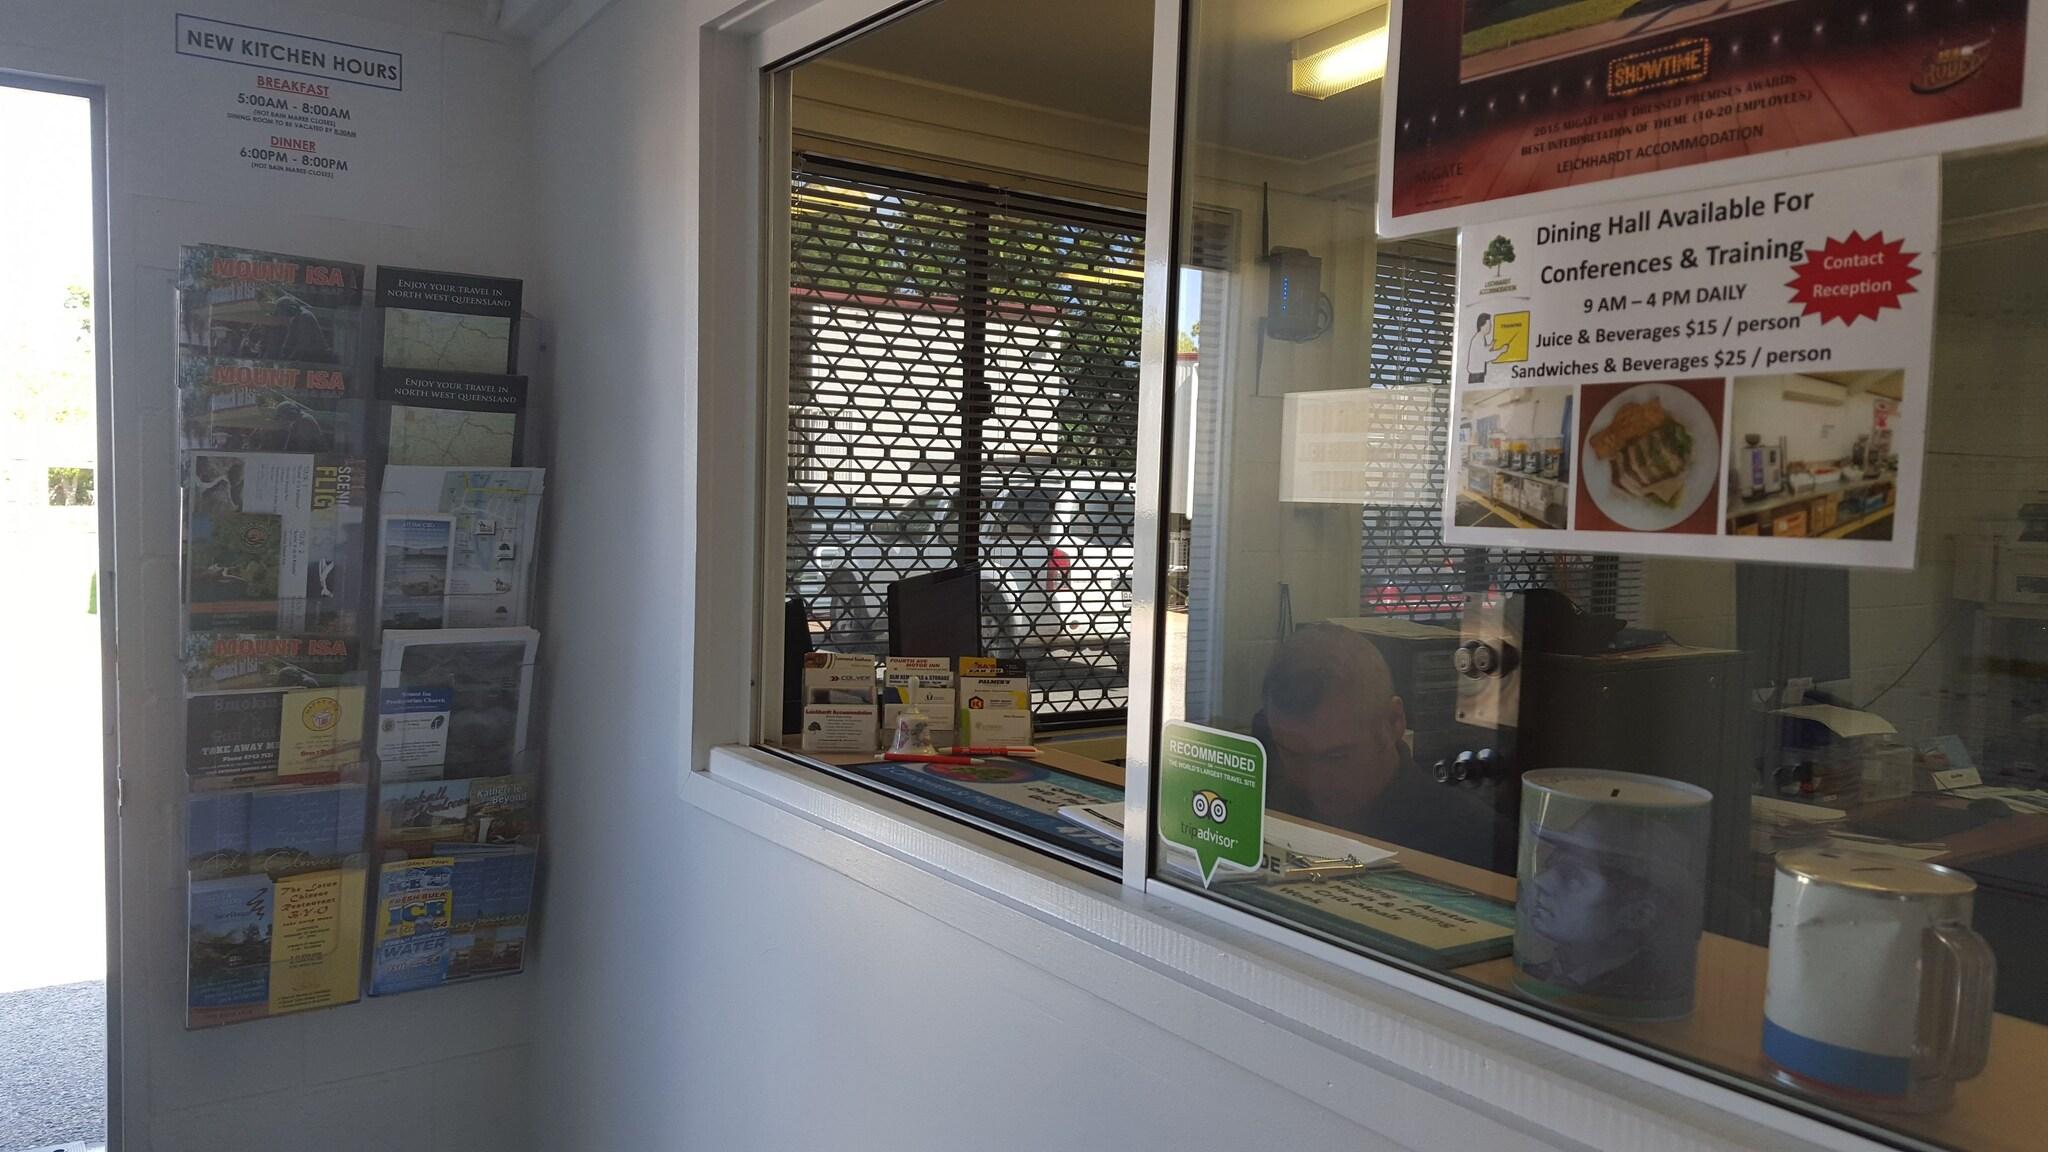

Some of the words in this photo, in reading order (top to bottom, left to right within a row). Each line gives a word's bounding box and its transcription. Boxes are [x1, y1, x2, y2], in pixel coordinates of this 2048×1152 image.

[187, 29, 235, 52] NEW
[241, 39, 326, 69] KITCHEN
[333, 55, 398, 81] HOURS
[1613, 50, 1701, 87] SHOWTIME
[256, 75, 329, 98] BREAKFAST
[1602, 109, 1628, 122] BEST
[1631, 97, 1680, 117] DRESSED
[1685, 87, 1742, 105] PREMISES
[1746, 73, 1798, 92] AWARDS
[237, 92, 289, 110] 5:00AM
[301, 102, 351, 120] 8:00AM
[1520, 142, 1545, 156] BEST
[1548, 125, 1633, 150] INTERPRETATION
[1636, 122, 1648, 132] OF
[1653, 113, 1687, 129] THEME
[1692, 104, 1733, 123] (10-20
[1736, 90, 1813, 113] EMPLOYEES)
[270, 135, 316, 153] DINNER
[1556, 148, 1633, 173] LEICHHARDT
[1636, 123, 1764, 159] ACCOMMODATION
[239, 146, 289, 163] 6:00PM
[301, 154, 349, 171] 8:00PM
[1536, 221, 1602, 246] Dining
[1608, 209, 1651, 236] Hall
[1657, 195, 1766, 230] Available
[1773, 192, 1815, 214] For
[211, 257, 299, 284] MOUNT
[305, 264, 345, 287] ISA
[1540, 254, 1673, 284] Conferences
[1679, 248, 1699, 269] &
[1706, 238, 1805, 267] Training
[1823, 252, 1885, 271] Contact
[387, 289, 421, 300] NORTH
[424, 292, 451, 302] WEST
[451, 294, 511, 307] QUEENSLAND
[399, 279, 430, 290] ENJOY
[430, 281, 456, 292] YOUR
[458, 285, 490, 296] TRAVEL
[1583, 299, 1594, 314] 9
[1598, 296, 1627, 313] AM
[1646, 293, 1657, 308] 4
[1662, 290, 1691, 307] PM
[1696, 282, 1748, 304] DAILY
[1812, 278, 1893, 298] Reception
[1535, 331, 1573, 348] Juice
[1577, 329, 1591, 344] &
[1595, 323, 1681, 343] Beverages
[1685, 318, 1718, 338] $15
[1722, 316, 1733, 337] /
[1737, 315, 1801, 336] person
[1511, 362, 1600, 379] Sandwiches
[1603, 358, 1617, 373] &
[1622, 353, 1709, 372] Beverages
[1714, 349, 1747, 369] $25
[1751, 347, 1762, 368] /
[1766, 347, 1832, 367] person
[212, 364, 300, 389] MOUNT
[306, 369, 345, 391] ISA
[405, 377, 434, 390] ENJOY
[436, 380, 463, 391] YOUR
[464, 383, 495, 394] TRAVEL
[498, 385, 509, 393] IN
[394, 387, 428, 399] NORTH
[431, 390, 456, 400] WEST
[457, 393, 517, 404] QUEENSLAND
[336, 465, 353, 506] SCENI
[213, 638, 300, 657] MOUNT
[308, 638, 348, 657] ISA
[201, 745, 231, 756] TAKE
[232, 742, 264, 753] AWAY
[1169, 740, 1256, 772] RECOMMENDED
[1179, 760, 1200, 774] WORLD'S
[1200, 767, 1223, 779] LARGEST
[1223, 773, 1244, 785] TRAVEL
[1244, 779, 1256, 789] SITE
[1179, 822, 1237, 849] tripadvisor
[281, 887, 301, 895] The
[305, 880, 338, 892] Lotus
[289, 890, 329, 903] Chinese
[280, 897, 337, 912] Restaurant
[1327, 885, 1376, 902] Meals
[1397, 907, 1456, 929] Dining
[1350, 902, 1401, 920] Meals
[1413, 904, 1478, 924] Austar
[384, 938, 446, 959] WATER
